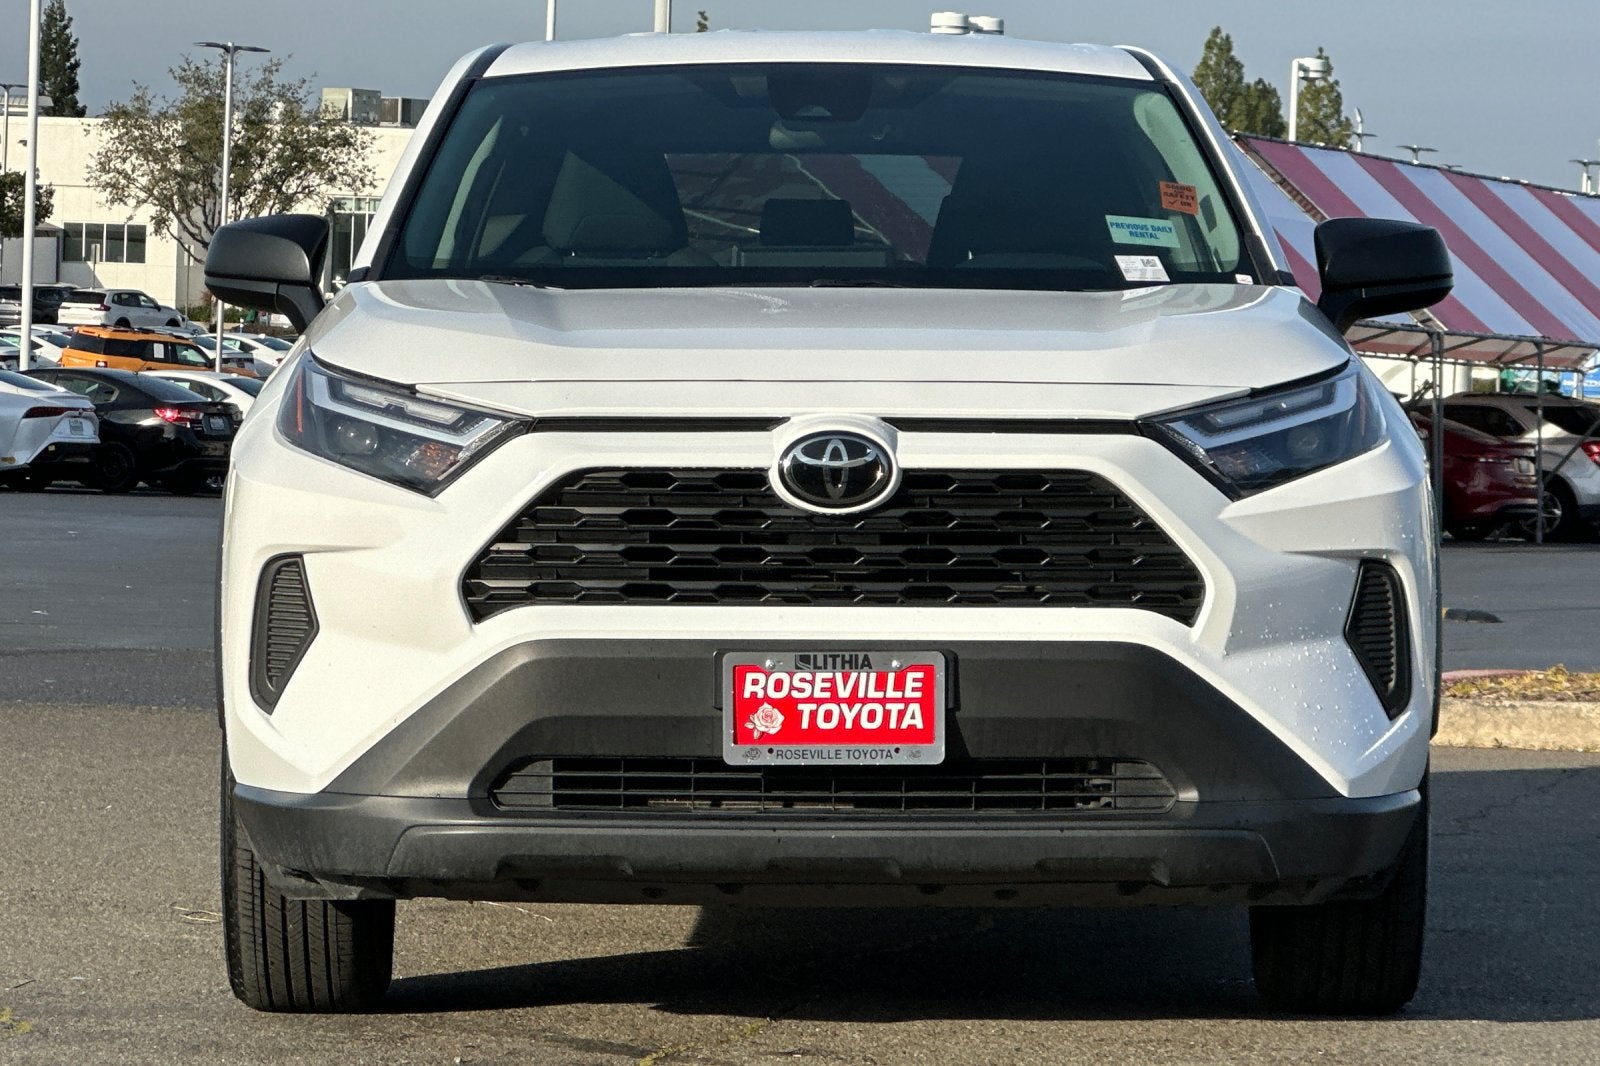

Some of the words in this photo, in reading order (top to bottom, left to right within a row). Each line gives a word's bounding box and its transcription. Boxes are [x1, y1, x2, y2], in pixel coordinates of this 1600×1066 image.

[1109, 221, 1150, 232] PREVIOUS
[1151, 224, 1173, 234] DAILY
[1128, 230, 1160, 240] RENTAL
[813, 654, 873, 670] LITHIA
[743, 671, 925, 699] ROSEVILLE
[797, 702, 924, 730] TOYOTA
[776, 749, 842, 760] ROSEVILLE
[846, 749, 893, 760] TOYOTA
